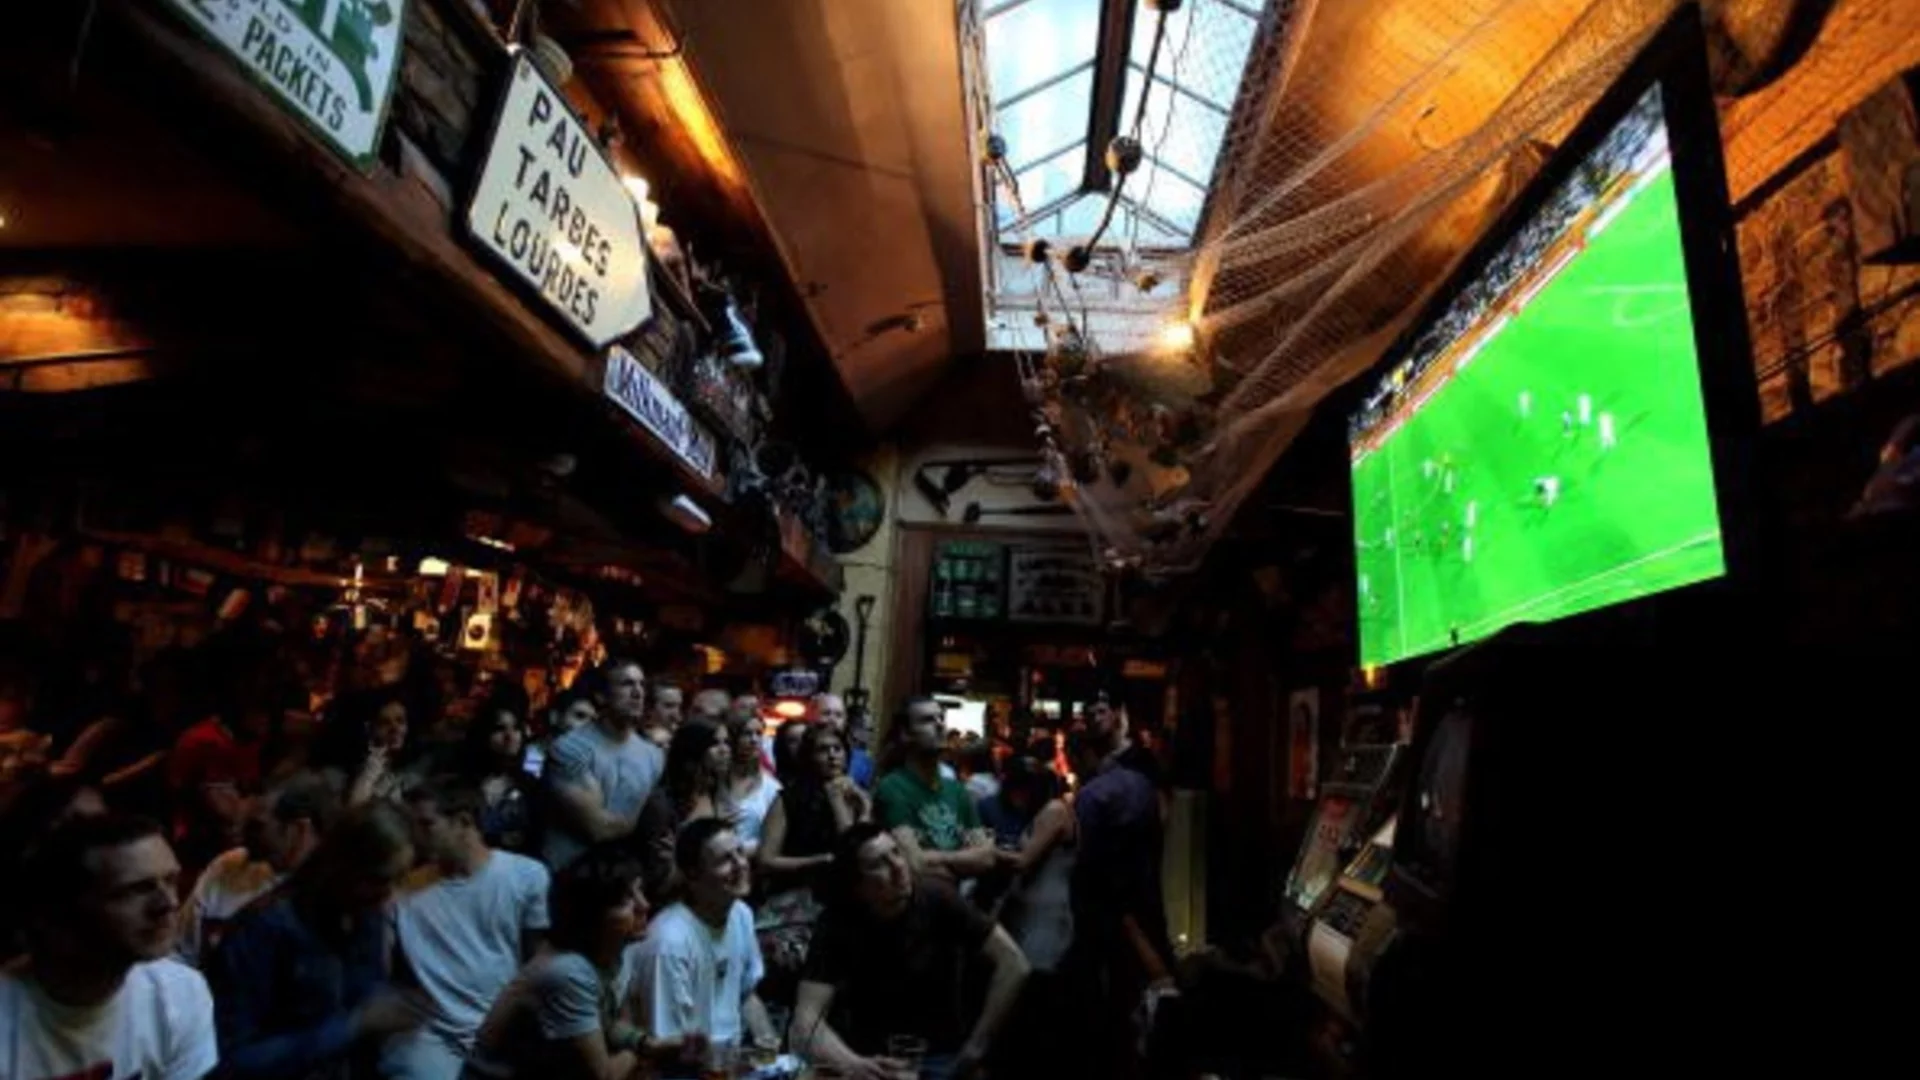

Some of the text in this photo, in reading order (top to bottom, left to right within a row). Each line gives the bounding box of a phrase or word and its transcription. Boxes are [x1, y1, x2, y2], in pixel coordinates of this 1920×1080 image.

[241, 16, 347, 132] PACKETS
[306, 44, 331, 72] IN
[528, 91, 588, 180] PAU
[493, 200, 599, 326] LOURDES
[515, 145, 612, 277] TARBES
